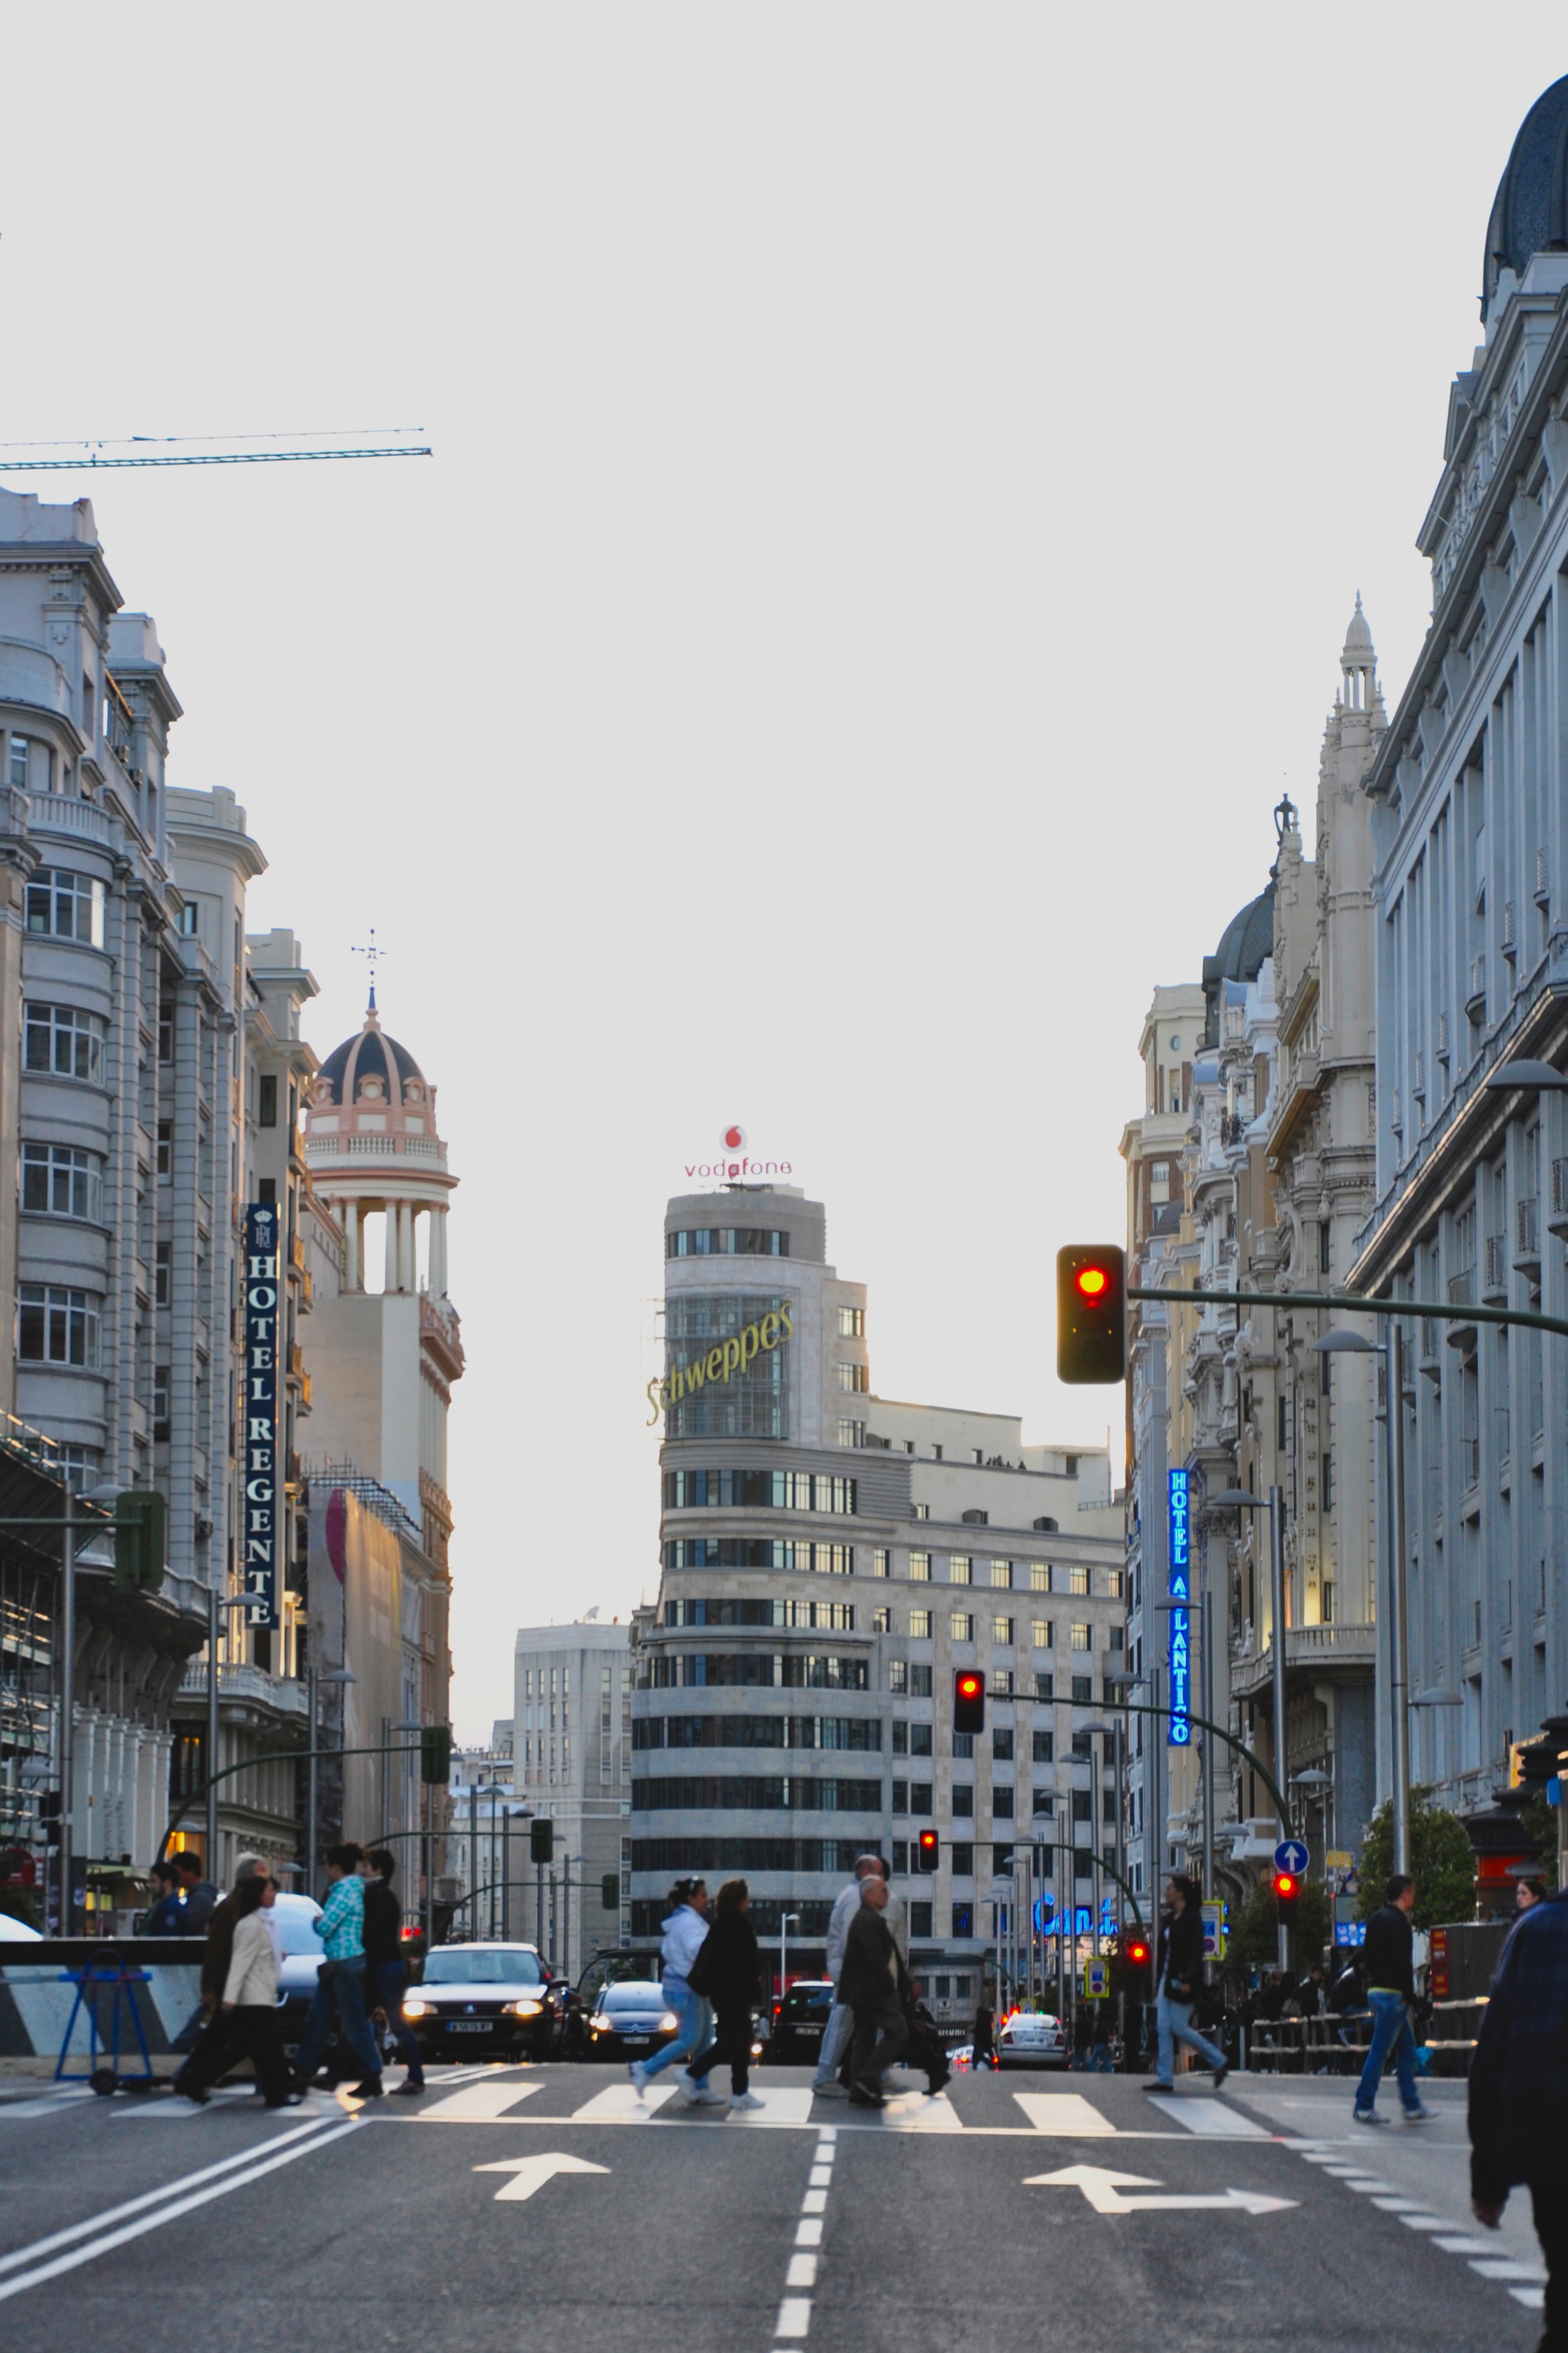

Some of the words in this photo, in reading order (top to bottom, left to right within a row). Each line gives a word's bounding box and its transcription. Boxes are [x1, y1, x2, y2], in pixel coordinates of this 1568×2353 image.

[684, 1157, 792, 1178] vodafone
[248, 1255, 276, 1400] HOTEL
[646, 1300, 794, 1427] Schweppes
[247, 1419, 274, 1624] REGENTE
[1172, 1472, 1187, 1565] HOTEL
